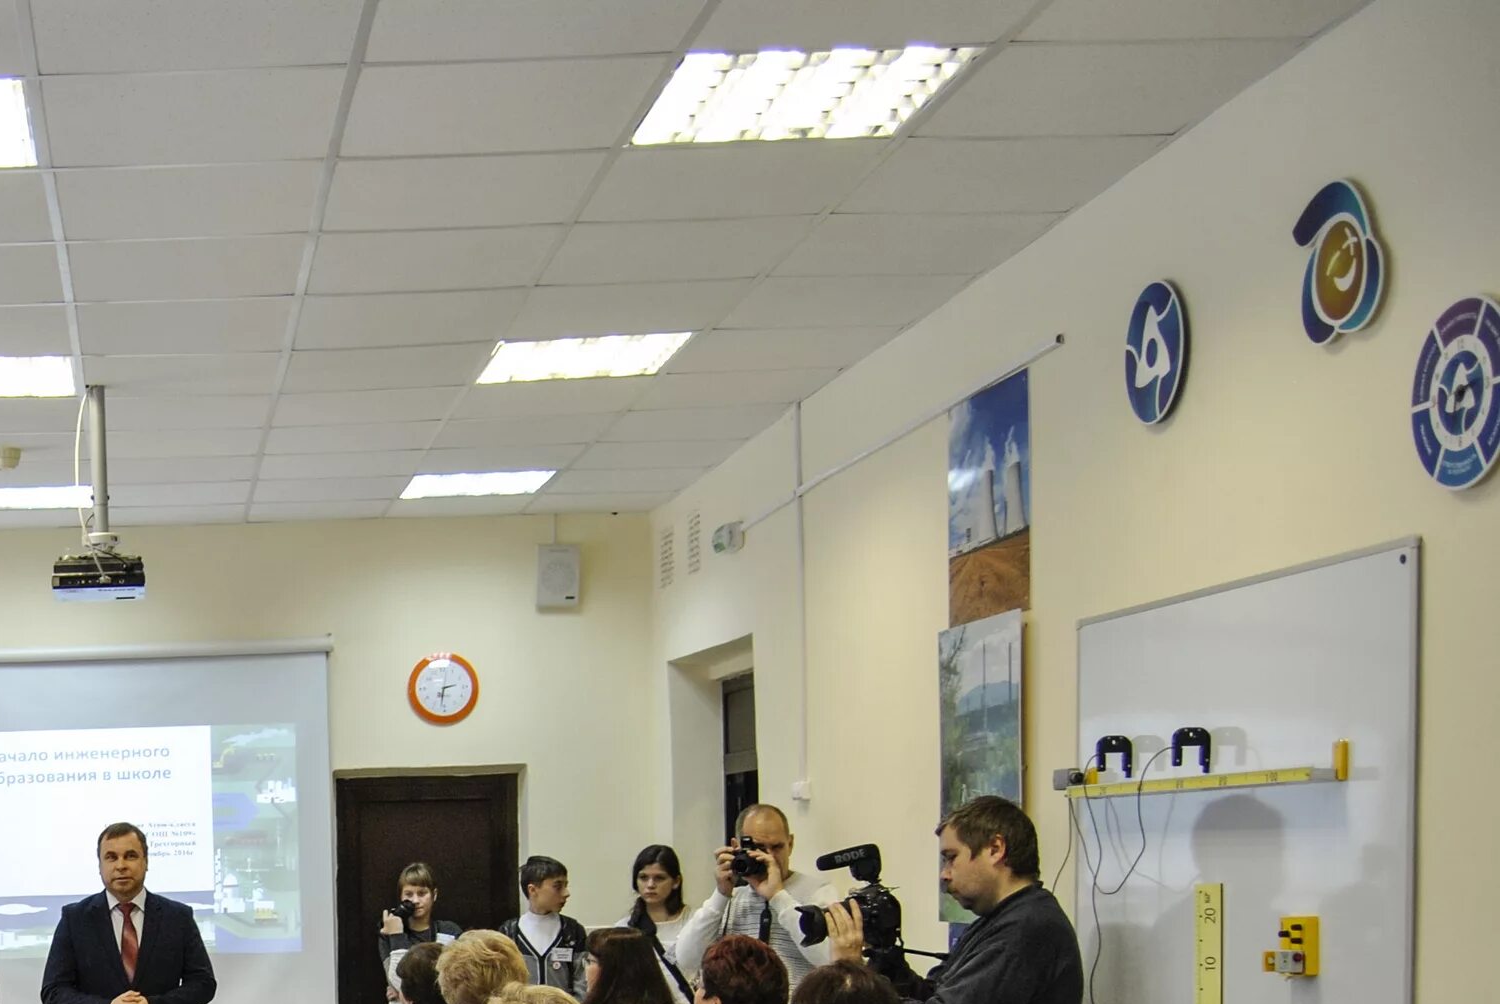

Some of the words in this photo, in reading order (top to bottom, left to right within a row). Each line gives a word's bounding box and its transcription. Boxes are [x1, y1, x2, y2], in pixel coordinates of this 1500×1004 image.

[54, 746, 170, 761] инженерного
[102, 771, 112, 781] в
[117, 767, 172, 781] школе
[1204, 908, 1216, 924] 20
[1205, 956, 1216, 971] 10
